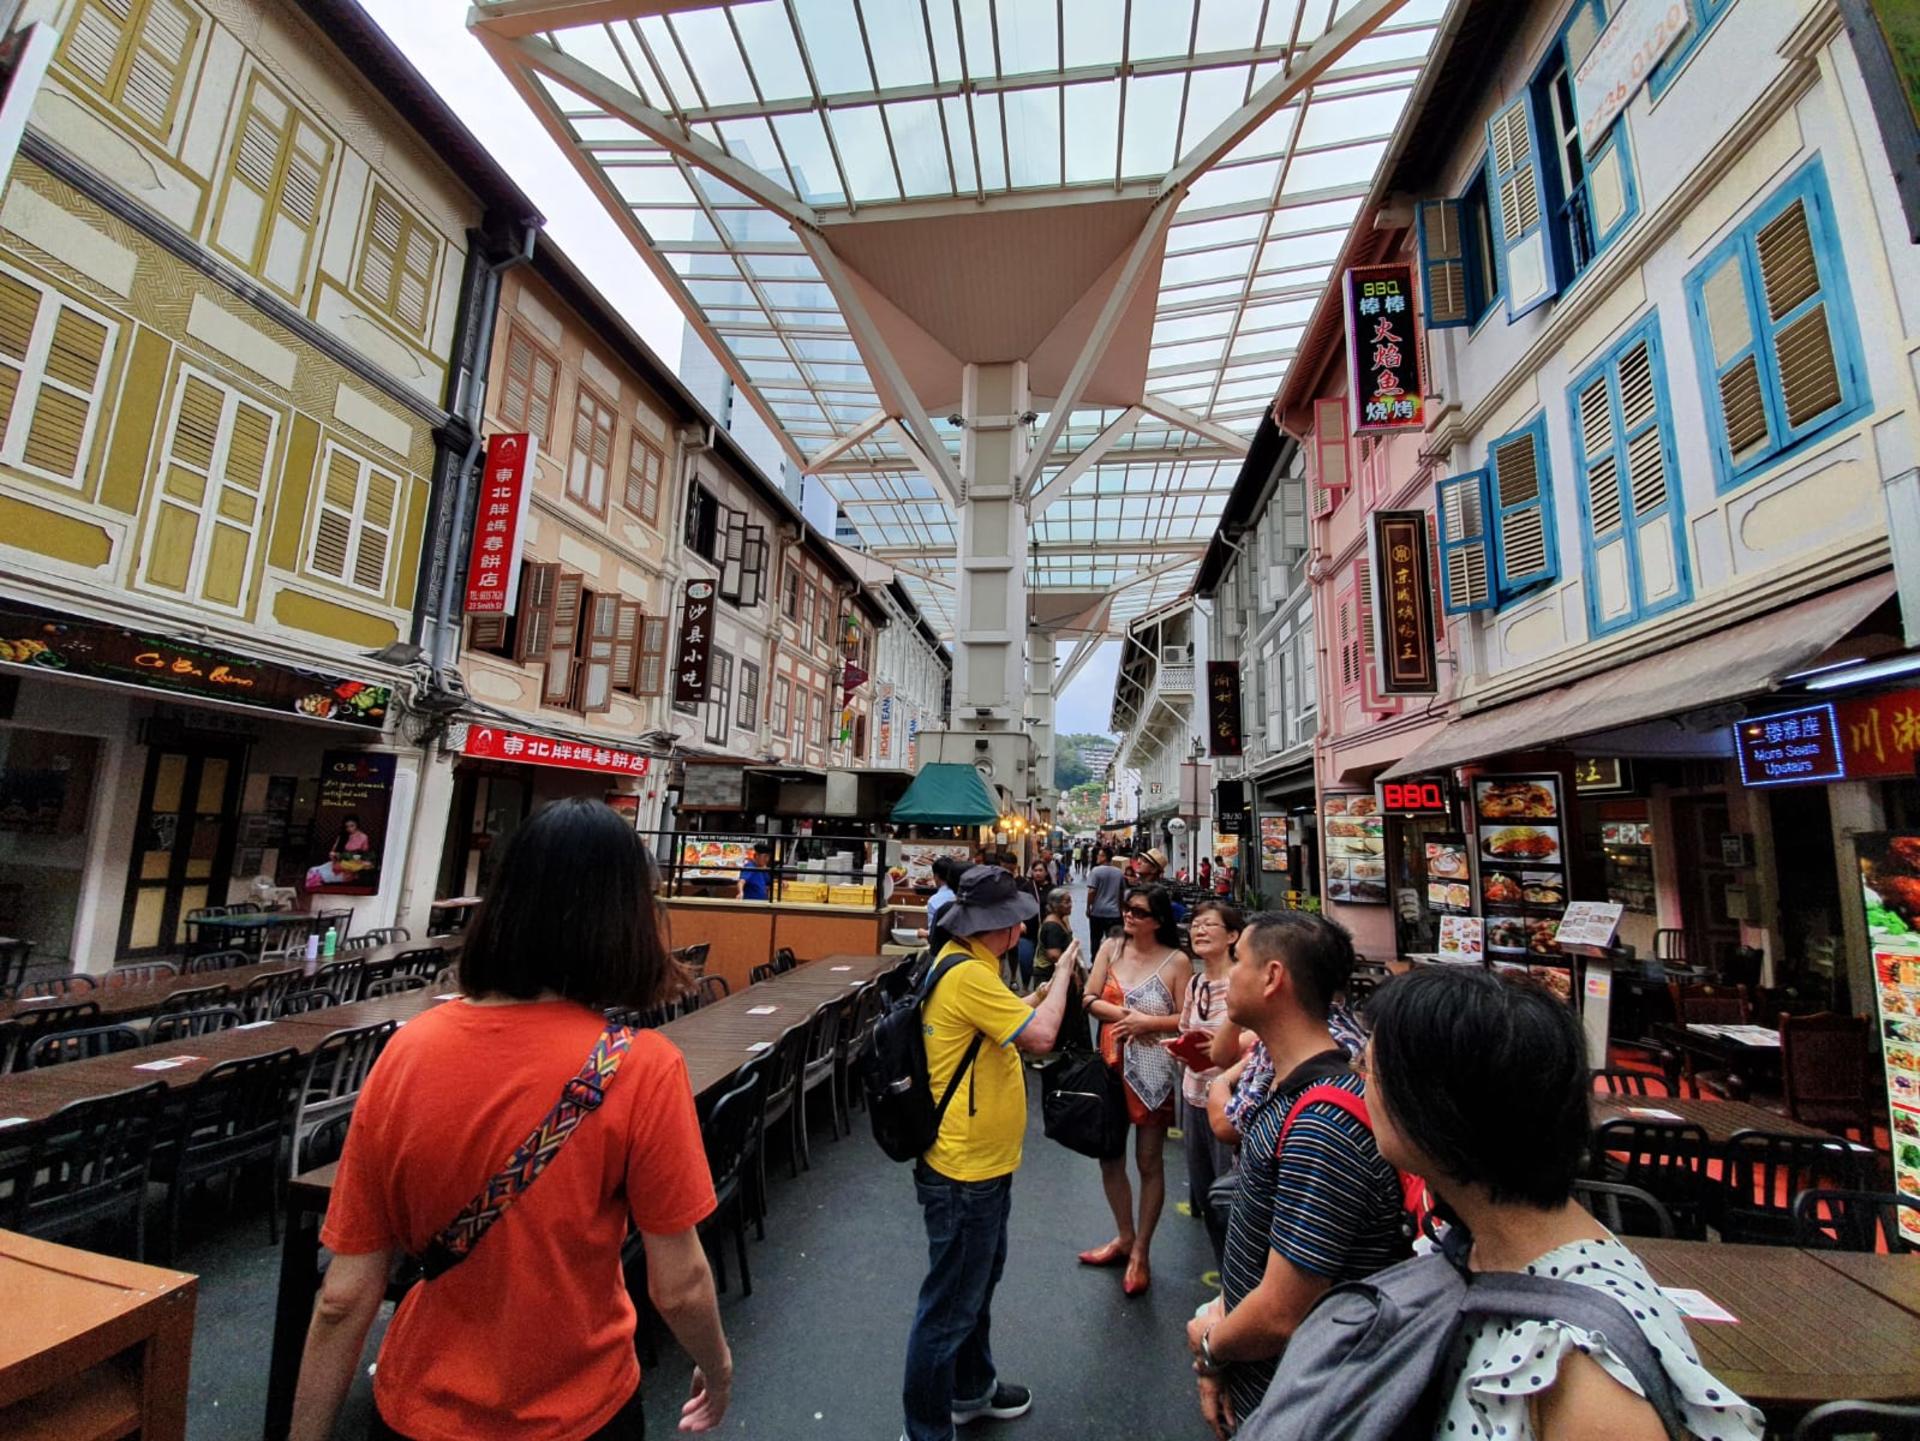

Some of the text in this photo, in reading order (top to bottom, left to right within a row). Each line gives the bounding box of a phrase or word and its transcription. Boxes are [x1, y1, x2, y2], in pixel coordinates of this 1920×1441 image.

[1363, 280, 1400, 297] BBQ
[682, 604, 707, 688] 沙县小吃
[1753, 743, 1821, 761] More Seats
[1764, 760, 1814, 777] Upstairs
[1384, 784, 1444, 808] BBQ
